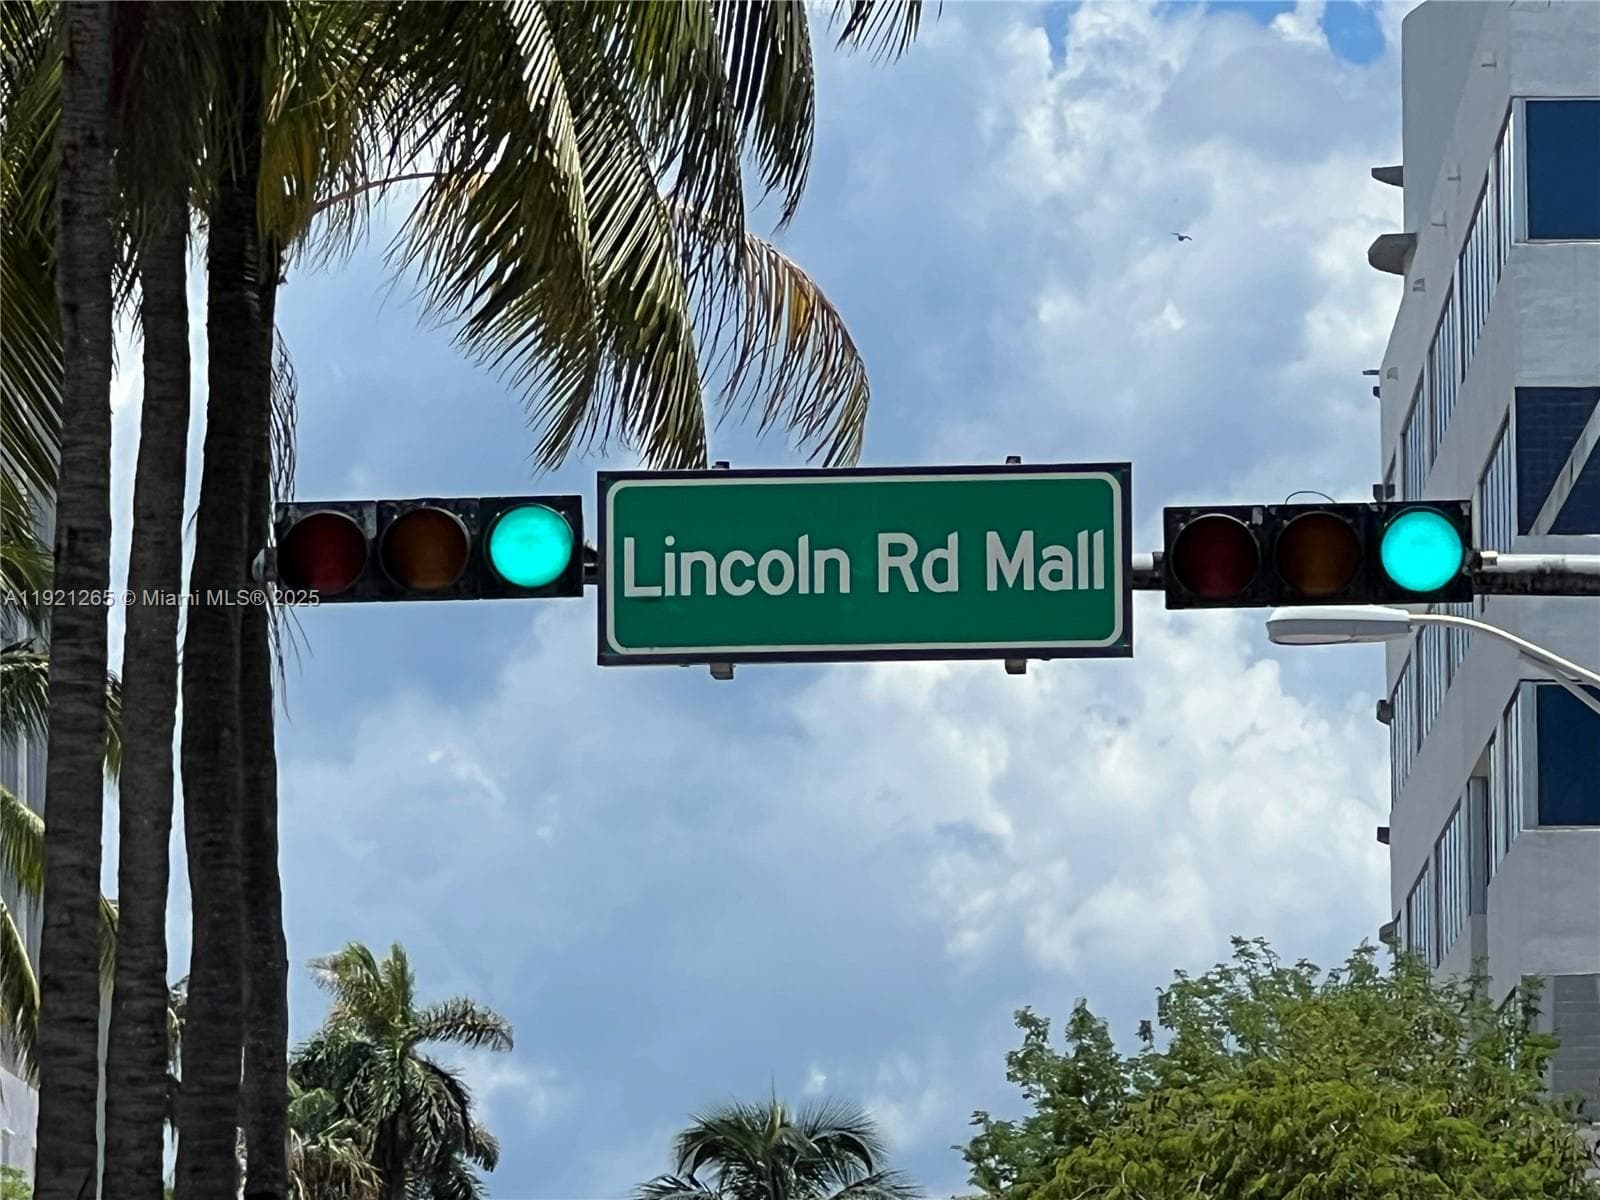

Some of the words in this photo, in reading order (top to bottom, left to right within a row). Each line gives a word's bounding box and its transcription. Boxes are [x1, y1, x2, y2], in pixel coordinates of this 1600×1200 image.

[623, 535, 850, 598] Lincoln
[877, 531, 959, 593] Rd
[986, 529, 1105, 592] Mall
